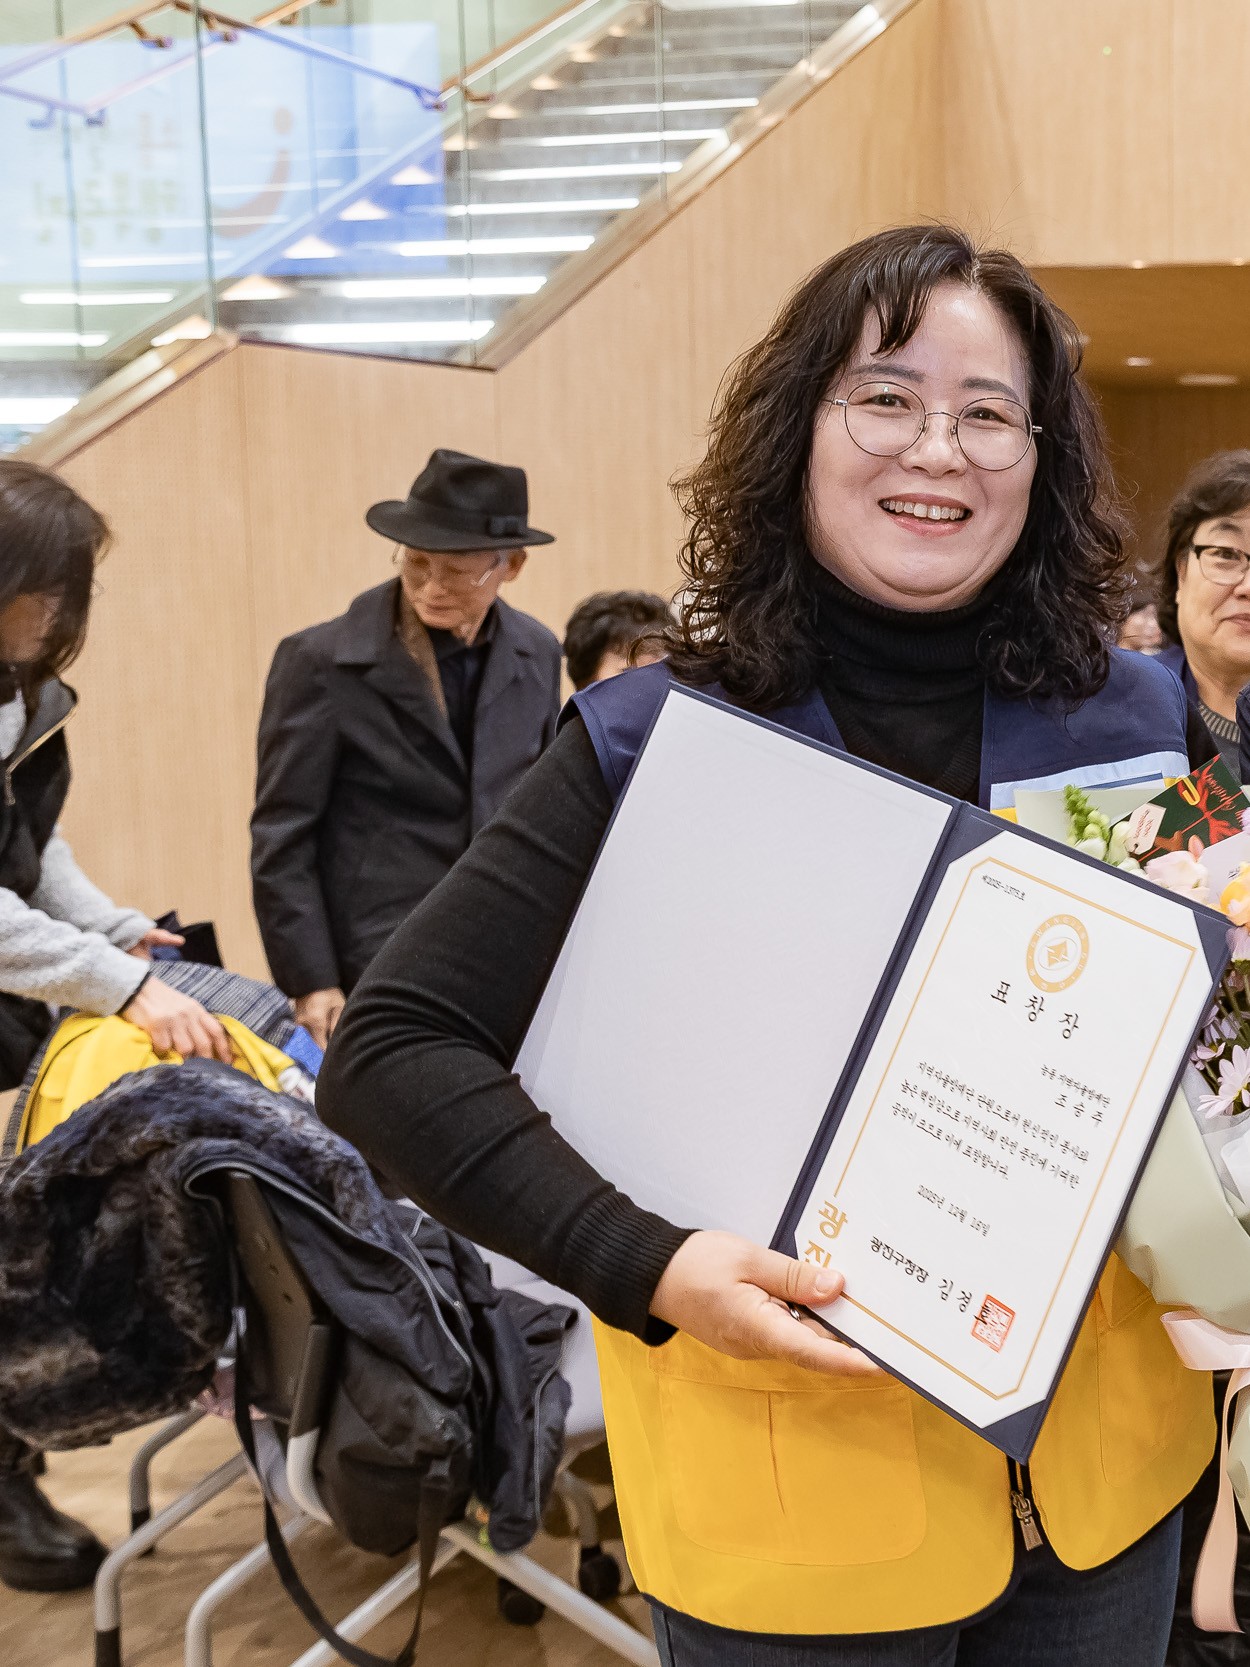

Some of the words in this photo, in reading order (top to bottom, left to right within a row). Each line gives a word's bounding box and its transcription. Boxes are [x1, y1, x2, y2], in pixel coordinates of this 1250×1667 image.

[892, 1102, 917, 1124] 공적이
[945, 1134, 963, 1151] 이에
[962, 1145, 1008, 1180] 표창합니다.
[901, 1079, 918, 1098] 높은
[921, 1090, 961, 1122] 책임감으로
[964, 1115, 998, 1143] 지역사회
[1000, 1136, 1018, 1155] 안전
[1019, 1147, 1048, 1170] 증진에
[1049, 1165, 1079, 1189] 기여한
[919, 1062, 974, 1102] 지역자율방재단
[977, 1095, 1020, 1125] 단원으로서
[1022, 1119, 1059, 1148] 헌신적인
[917, 1185, 945, 1209] 2025년
[948, 1203, 967, 1223] 12월
[870, 1236, 929, 1283] 광진구청장
